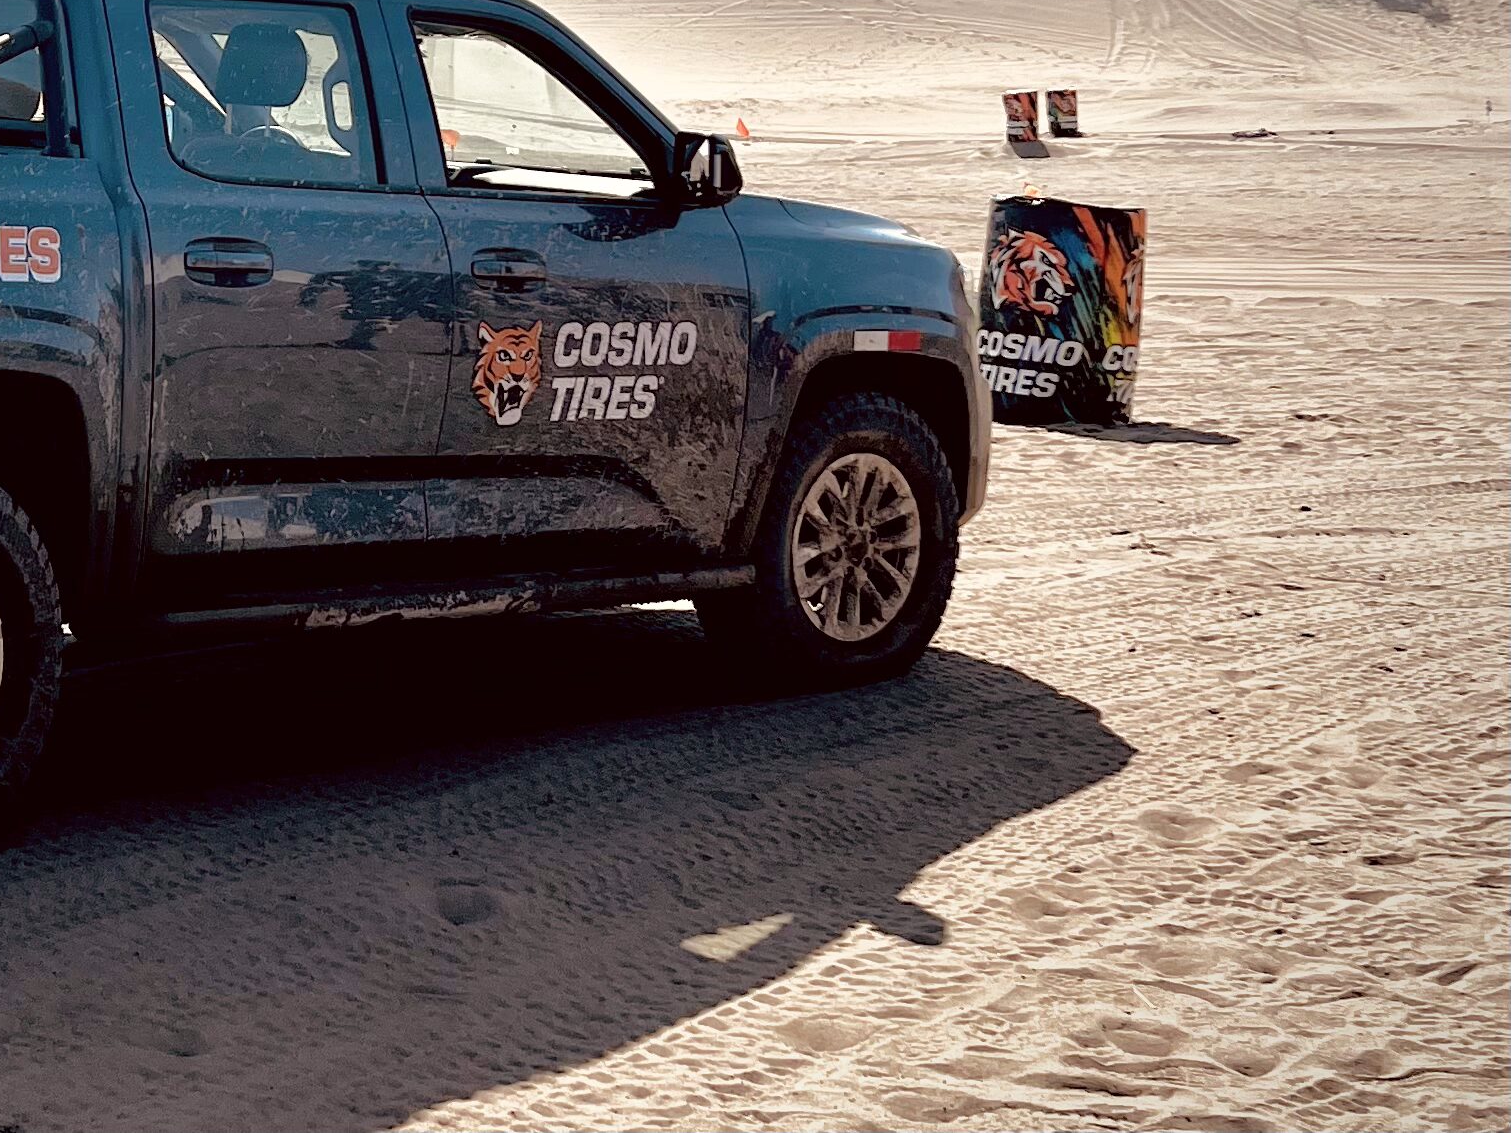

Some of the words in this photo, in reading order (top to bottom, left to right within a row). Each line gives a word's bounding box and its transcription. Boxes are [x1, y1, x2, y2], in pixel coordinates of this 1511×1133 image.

[553, 321, 697, 368] COSMO
[976, 329, 1084, 368] COSMO
[549, 374, 660, 422] TIRES
